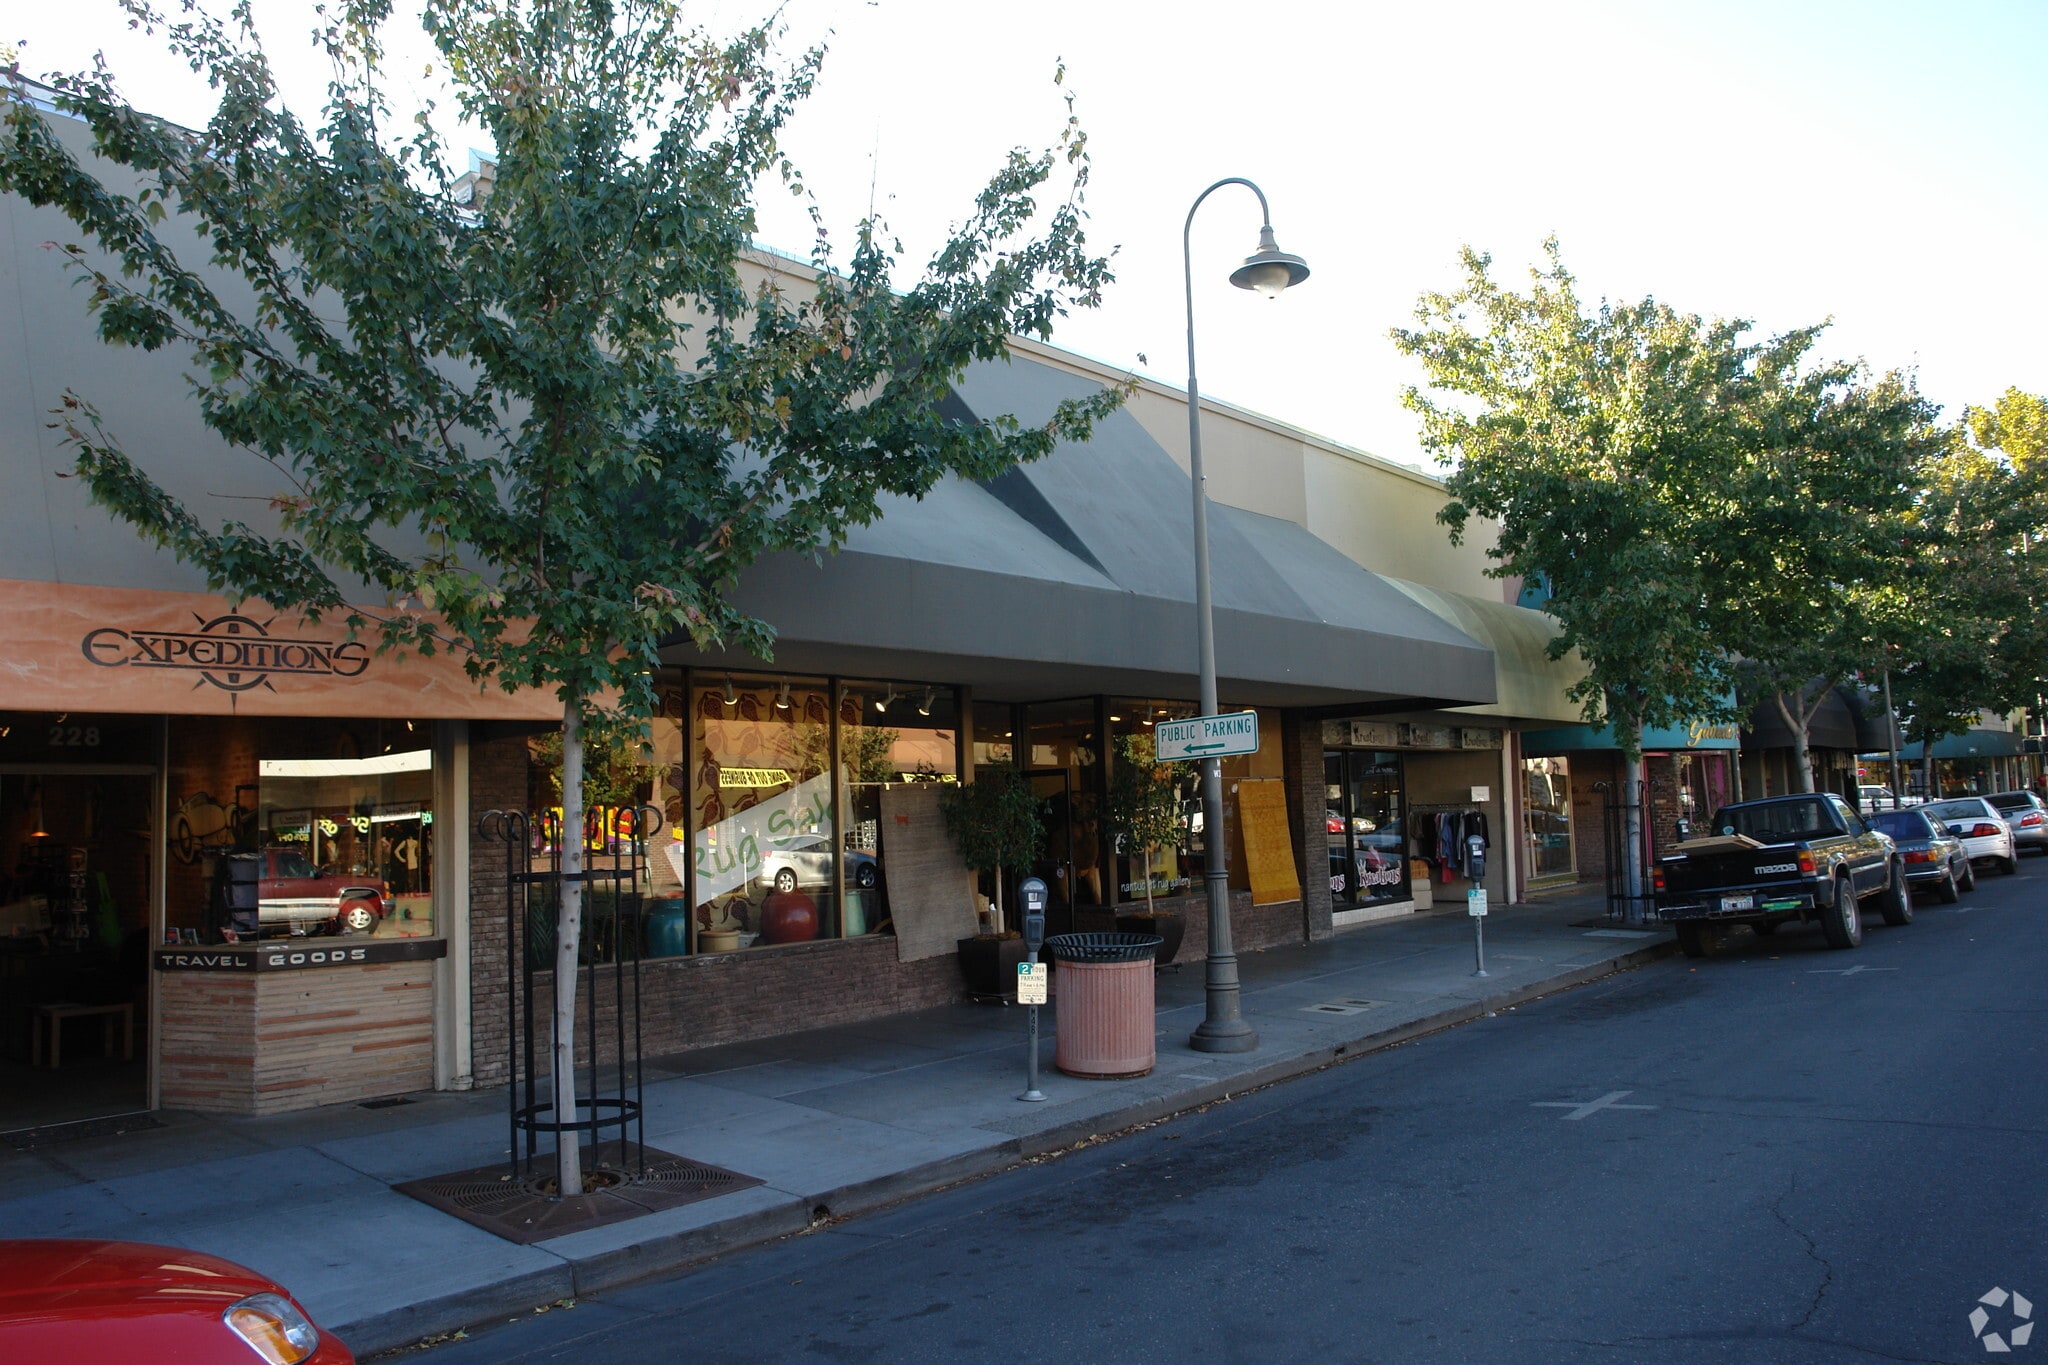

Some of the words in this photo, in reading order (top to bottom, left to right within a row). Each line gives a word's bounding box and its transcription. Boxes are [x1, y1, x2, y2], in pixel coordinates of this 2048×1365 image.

[82, 627, 370, 678] EXPEDITIONS
[47, 725, 101, 747] 228
[1161, 724, 1196, 743] PUBLIC
[1204, 718, 1251, 738] PARKING
[161, 954, 248, 967] TRAVEL
[268, 948, 367, 966] GOODS
[1021, 964, 1030, 974] 2
